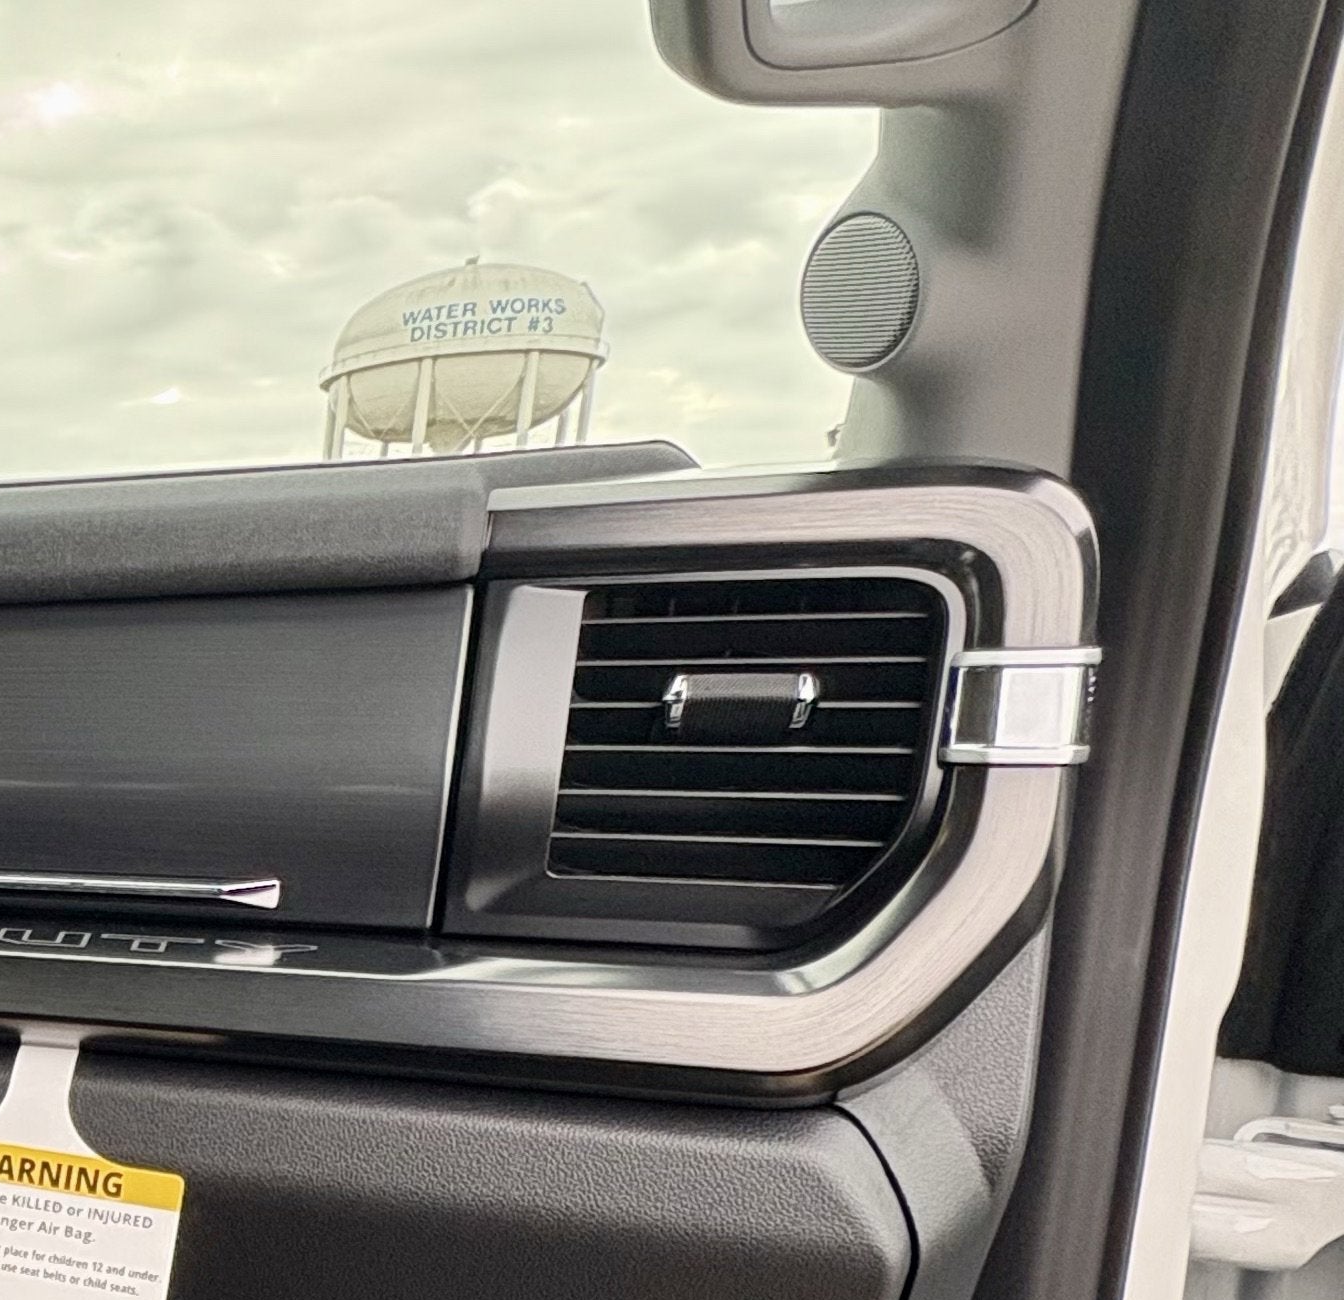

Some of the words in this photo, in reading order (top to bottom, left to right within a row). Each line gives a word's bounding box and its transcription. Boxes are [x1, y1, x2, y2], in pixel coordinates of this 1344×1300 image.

[402, 302, 478, 326] WATER
[489, 298, 567, 315] WORKS
[410, 317, 518, 342] DISTRICT
[528, 316, 554, 334] #3
[12, 1194, 63, 1213] KILLED
[66, 1206, 84, 1217] or
[88, 1208, 153, 1229] INJURED
[37, 1221, 60, 1235] Air
[64, 1226, 95, 1244] Bag.
[1, 1263, 18, 1273] use
[20, 1265, 40, 1277] seat
[43, 1269, 66, 1282] belts
[69, 1275, 80, 1285] or
[83, 1277, 107, 1290] child
[110, 1283, 139, 1296] seats.
[4, 1246, 29, 1259] place
[32, 1250, 46, 1261] for
[48, 1254, 88, 1269] children
[92, 1262, 103, 1273] 12
[106, 1265, 126, 1276] and
[128, 1269, 162, 1283] under.
